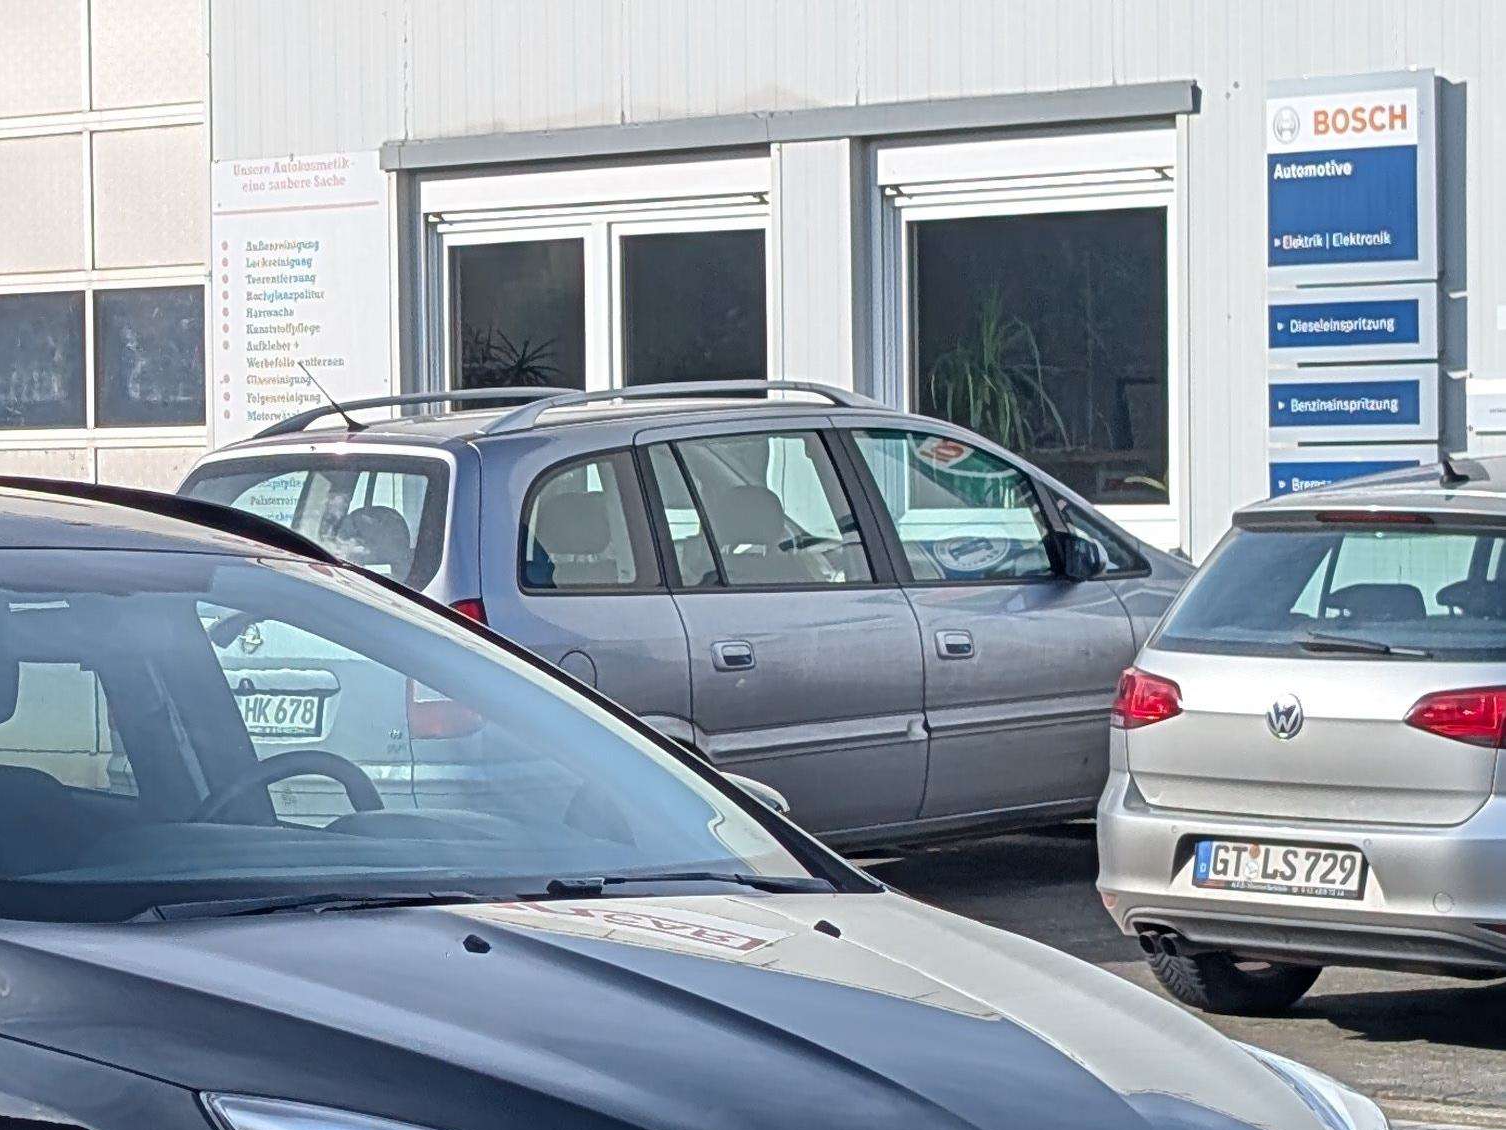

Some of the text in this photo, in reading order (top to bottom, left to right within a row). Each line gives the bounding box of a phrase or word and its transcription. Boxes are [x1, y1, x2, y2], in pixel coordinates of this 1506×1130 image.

[1313, 104, 1408, 136] BOSCH
[233, 163, 271, 177] Unsere
[1273, 159, 1352, 180] Automotive
[242, 175, 347, 192] eine saubere Sache
[1282, 232, 1323, 250] Elektrik
[1332, 230, 1392, 248] Elektronik
[1290, 317, 1396, 333] Dieseleinspritzung
[1290, 397, 1399, 413] Benzineinspritzung
[244, 697, 316, 724] HK 678
[1212, 844, 1357, 886] GT LS 729
